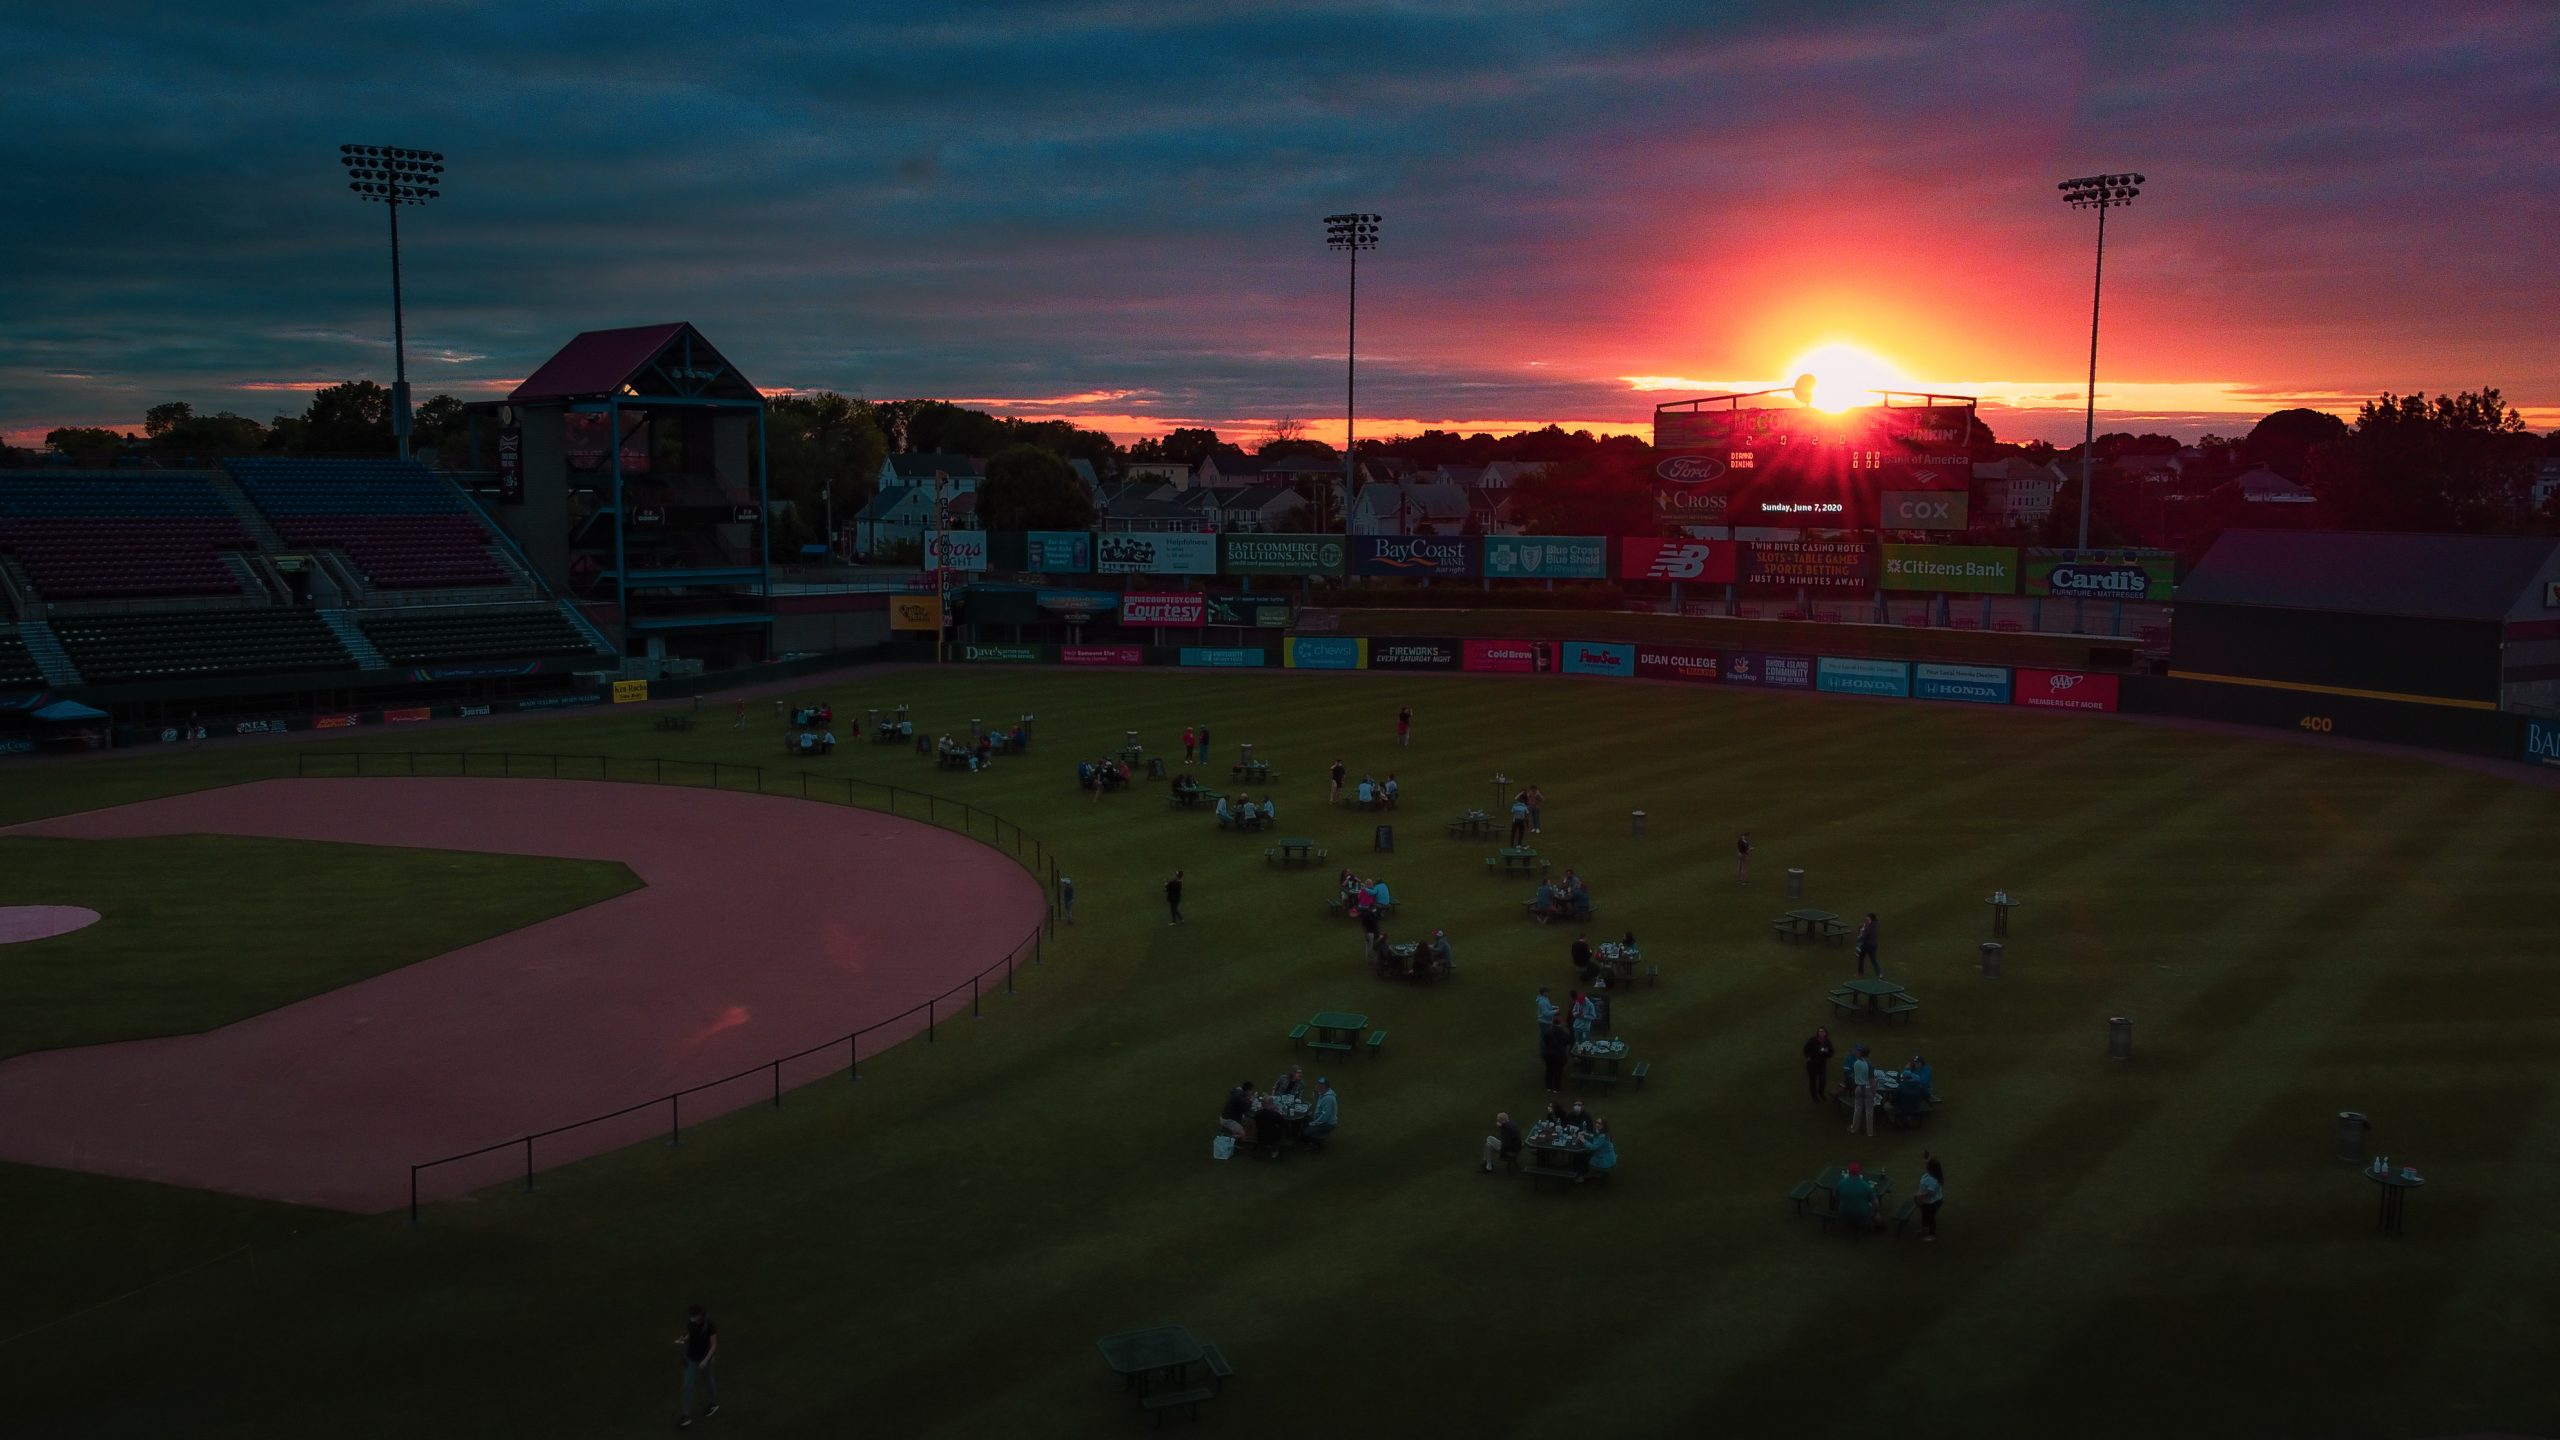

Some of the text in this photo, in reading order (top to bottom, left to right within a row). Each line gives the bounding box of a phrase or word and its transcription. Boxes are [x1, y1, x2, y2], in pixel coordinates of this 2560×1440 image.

[1883, 453, 1968, 465] Bank of America
[1670, 459, 1712, 478] Ford
[1761, 503, 1843, 512] Sunday, June 7, 2020
[1899, 501, 1949, 519] COX
[1166, 538, 1208, 547] Helpfulness
[1228, 542, 1318, 552] EAST COMMERCE
[1750, 542, 1865, 553] TWIN RIVER CASINO HOTEL
[1375, 538, 1465, 563] BayCoast
[1546, 545, 1600, 555] Blue Cross
[1228, 551, 1318, 562] SOLUTIONS, INC
[1440, 558, 1464, 566] BANK
[1546, 555, 1600, 564] Blue Shield
[1756, 552, 1858, 564] SLOTS TABLE GAMES
[1765, 564, 1849, 575] SPORTS BETTING
[1903, 560, 2005, 577] Citizens Bank
[1750, 574, 1864, 587] JUST 15 MINUTES AWAY!
[2052, 569, 2145, 591] Cardi's
[2052, 589, 2144, 599] FURNITURE MATTRESSES
[1123, 602, 1202, 622] Courtesy
[965, 646, 1003, 660] Dave's
[1389, 646, 1439, 656] FIREWORKS
[1487, 650, 1532, 659] Cold Brew
[1399, 655, 1432, 663] SATURDAY
[1641, 654, 1717, 669] DEAN COLLEGE
[1786, 660, 1809, 669] ISLAND
[1765, 666, 1809, 678] COMMUNITY
[1841, 679, 1897, 690] HONDA
[1939, 684, 1997, 696] HONDA
[2028, 697, 2103, 709] MEMBERS GET MORE
